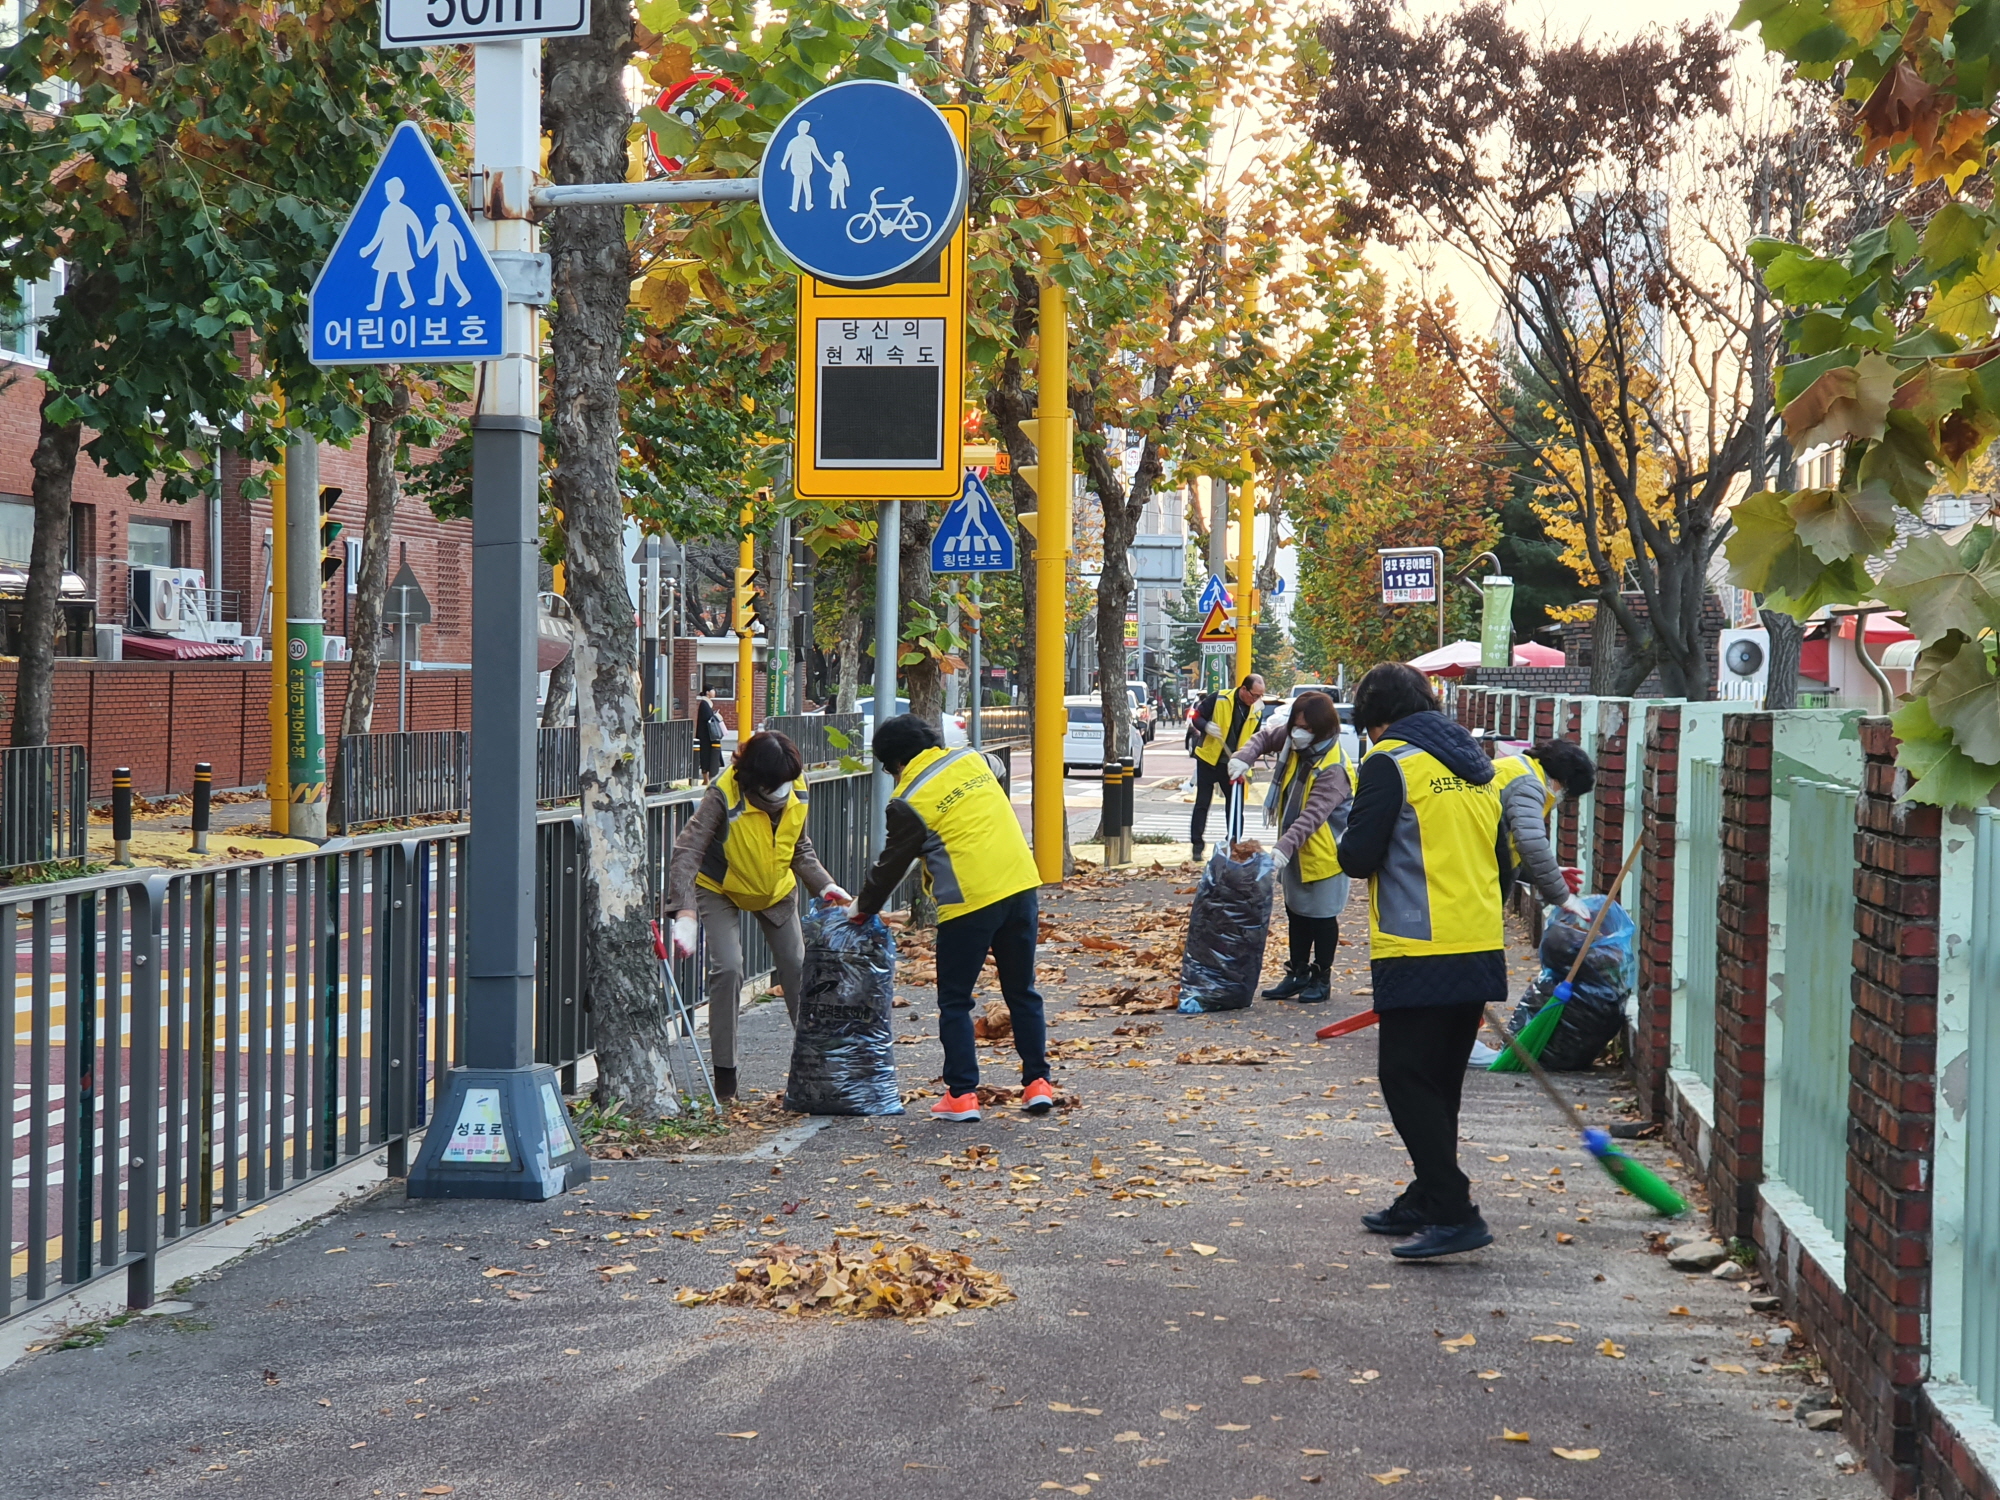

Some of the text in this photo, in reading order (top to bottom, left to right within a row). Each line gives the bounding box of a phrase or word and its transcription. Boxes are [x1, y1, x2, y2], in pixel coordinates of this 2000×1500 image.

[324, 315, 488, 350] 어린이보호
[943, 554, 1003, 567] 횡단보도
[1384, 557, 1432, 571] 성포 주공아파트
[1387, 573, 1430, 587] 11단지
[290, 644, 303, 654] 30
[290, 668, 307, 759] 어린이보호구역
[457, 1122, 503, 1136] 성포로
